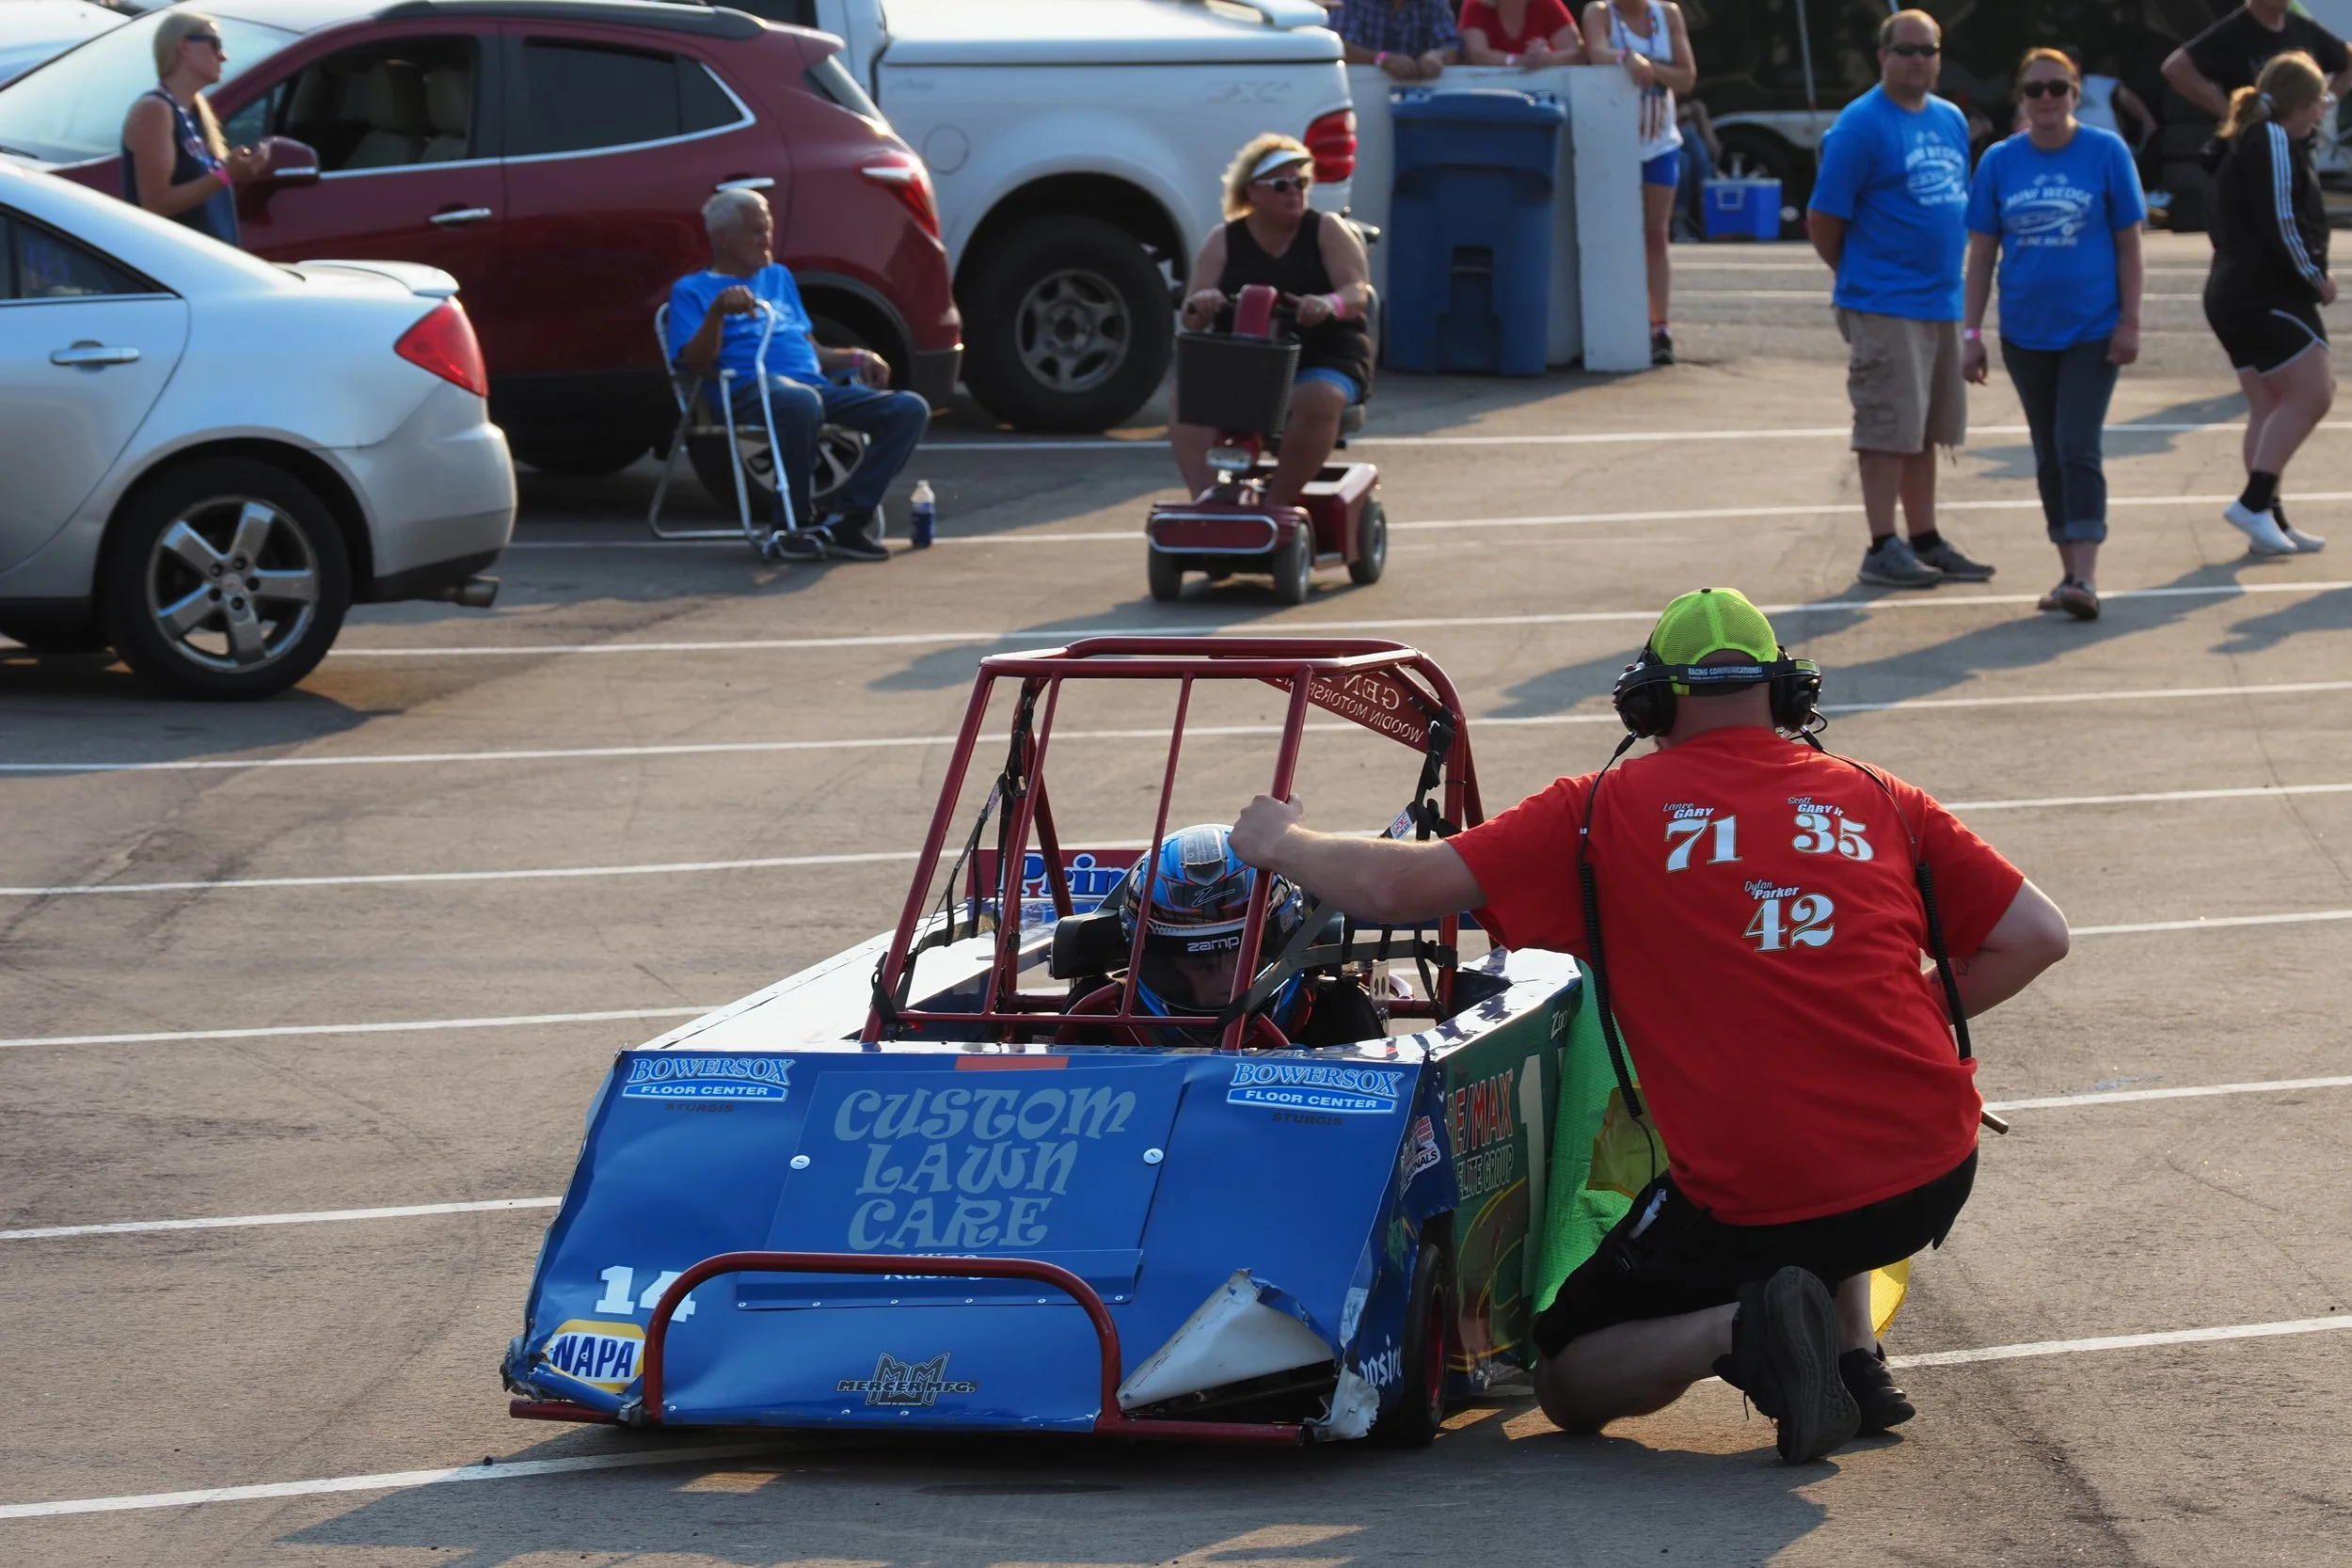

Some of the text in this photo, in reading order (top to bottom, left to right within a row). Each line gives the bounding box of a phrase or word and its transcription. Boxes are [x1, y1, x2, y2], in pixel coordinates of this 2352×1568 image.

[2042, 186, 2093, 206] WEDGE
[1688, 667, 1708, 675] RACING
[1662, 801, 1693, 813] Lance
[1788, 798, 1813, 806] Scott
[1797, 803, 1833, 814] GARY
[1673, 807, 1714, 819] GARY
[1664, 815, 1743, 873] 71
[1792, 813, 1874, 863] 35
[1754, 886, 1800, 900] Parker
[1742, 893, 1836, 952] 42
[1187, 936, 1240, 952] zamp
[628, 1058, 796, 1085] BOWERSOX
[1230, 1063, 1405, 1098] BOWERSOX
[641, 1086, 769, 1096] FLOOR CENTER
[1245, 1090, 1377, 1108] FLOOR CENTER
[665, 1102, 735, 1114] STURGIS
[834, 1086, 1136, 1141] CUSTOM
[1272, 1112, 1343, 1126] STURGIS
[855, 1140, 1078, 1196] LAWN
[1484, 1145, 1515, 1192] GROUP
[848, 1195, 1054, 1251] CARE
[596, 1265, 696, 1323] 14
[551, 1335, 636, 1378] NAPA
[836, 1380, 976, 1393] MERCER MFG.
